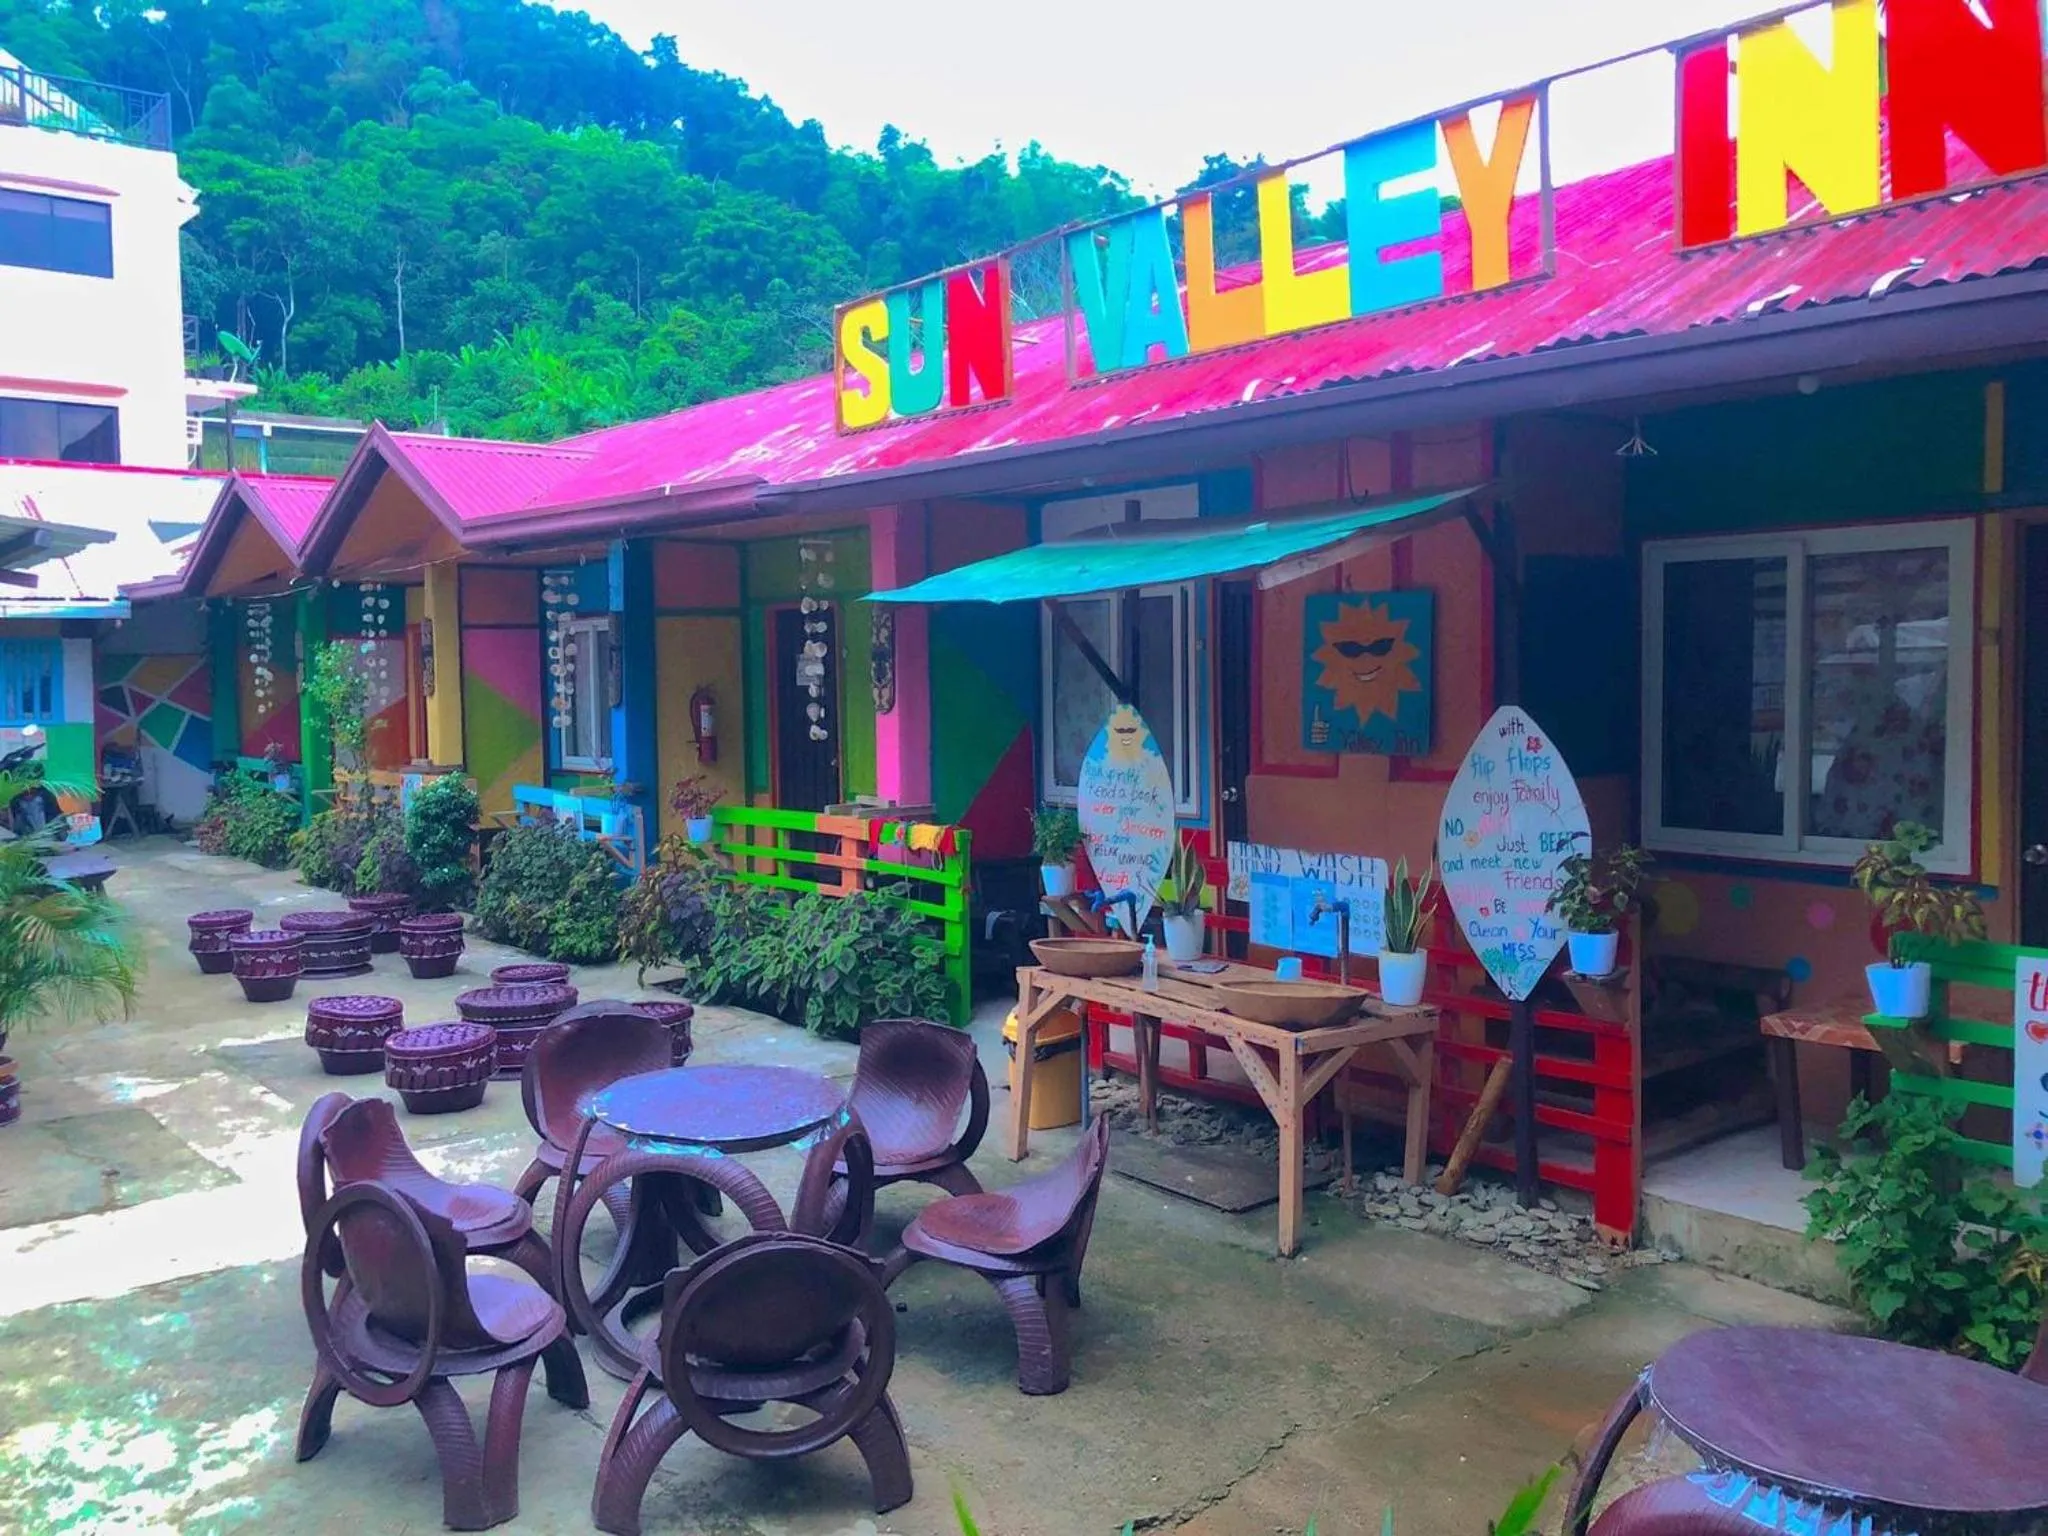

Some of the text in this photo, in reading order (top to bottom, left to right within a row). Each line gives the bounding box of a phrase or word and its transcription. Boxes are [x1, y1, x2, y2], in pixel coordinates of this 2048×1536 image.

[839, 0, 2048, 430] SUN VALLEY INN
[1499, 716, 1525, 739] with
[1471, 746, 1551, 782] flip flops
[1473, 774, 1561, 818] enjoy Family
[1445, 818, 1464, 840] NO
[1496, 833, 1528, 854] Just
[1232, 842, 1376, 890] HAND WASH
[1442, 853, 1544, 874] and meet new
[1504, 870, 1565, 892] Friends
[1468, 917, 1560, 942] Clean Your
[1502, 942, 1537, 962] MESS
